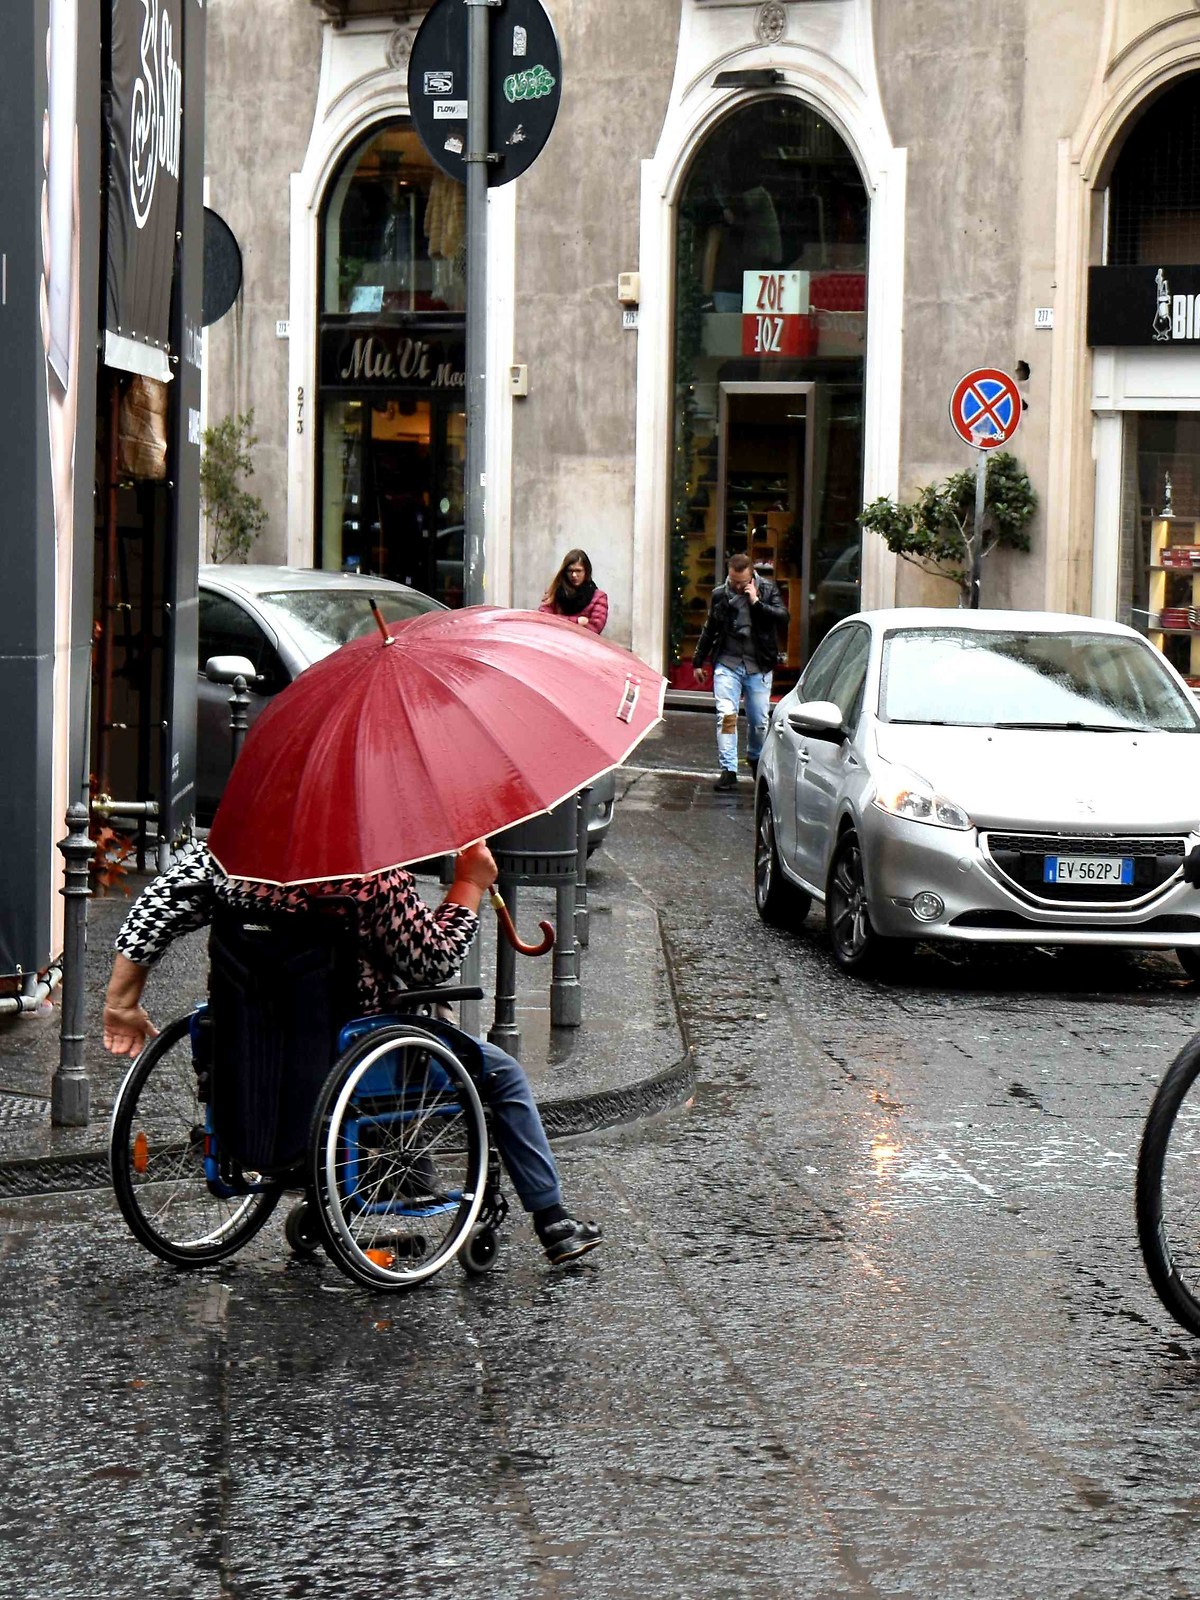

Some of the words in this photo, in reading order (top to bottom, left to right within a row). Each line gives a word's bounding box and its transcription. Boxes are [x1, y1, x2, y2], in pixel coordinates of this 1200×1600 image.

[756, 274, 785, 311] ZOE
[1058, 861, 1075, 879] EV
[1079, 862, 1122, 880] 562PJ
